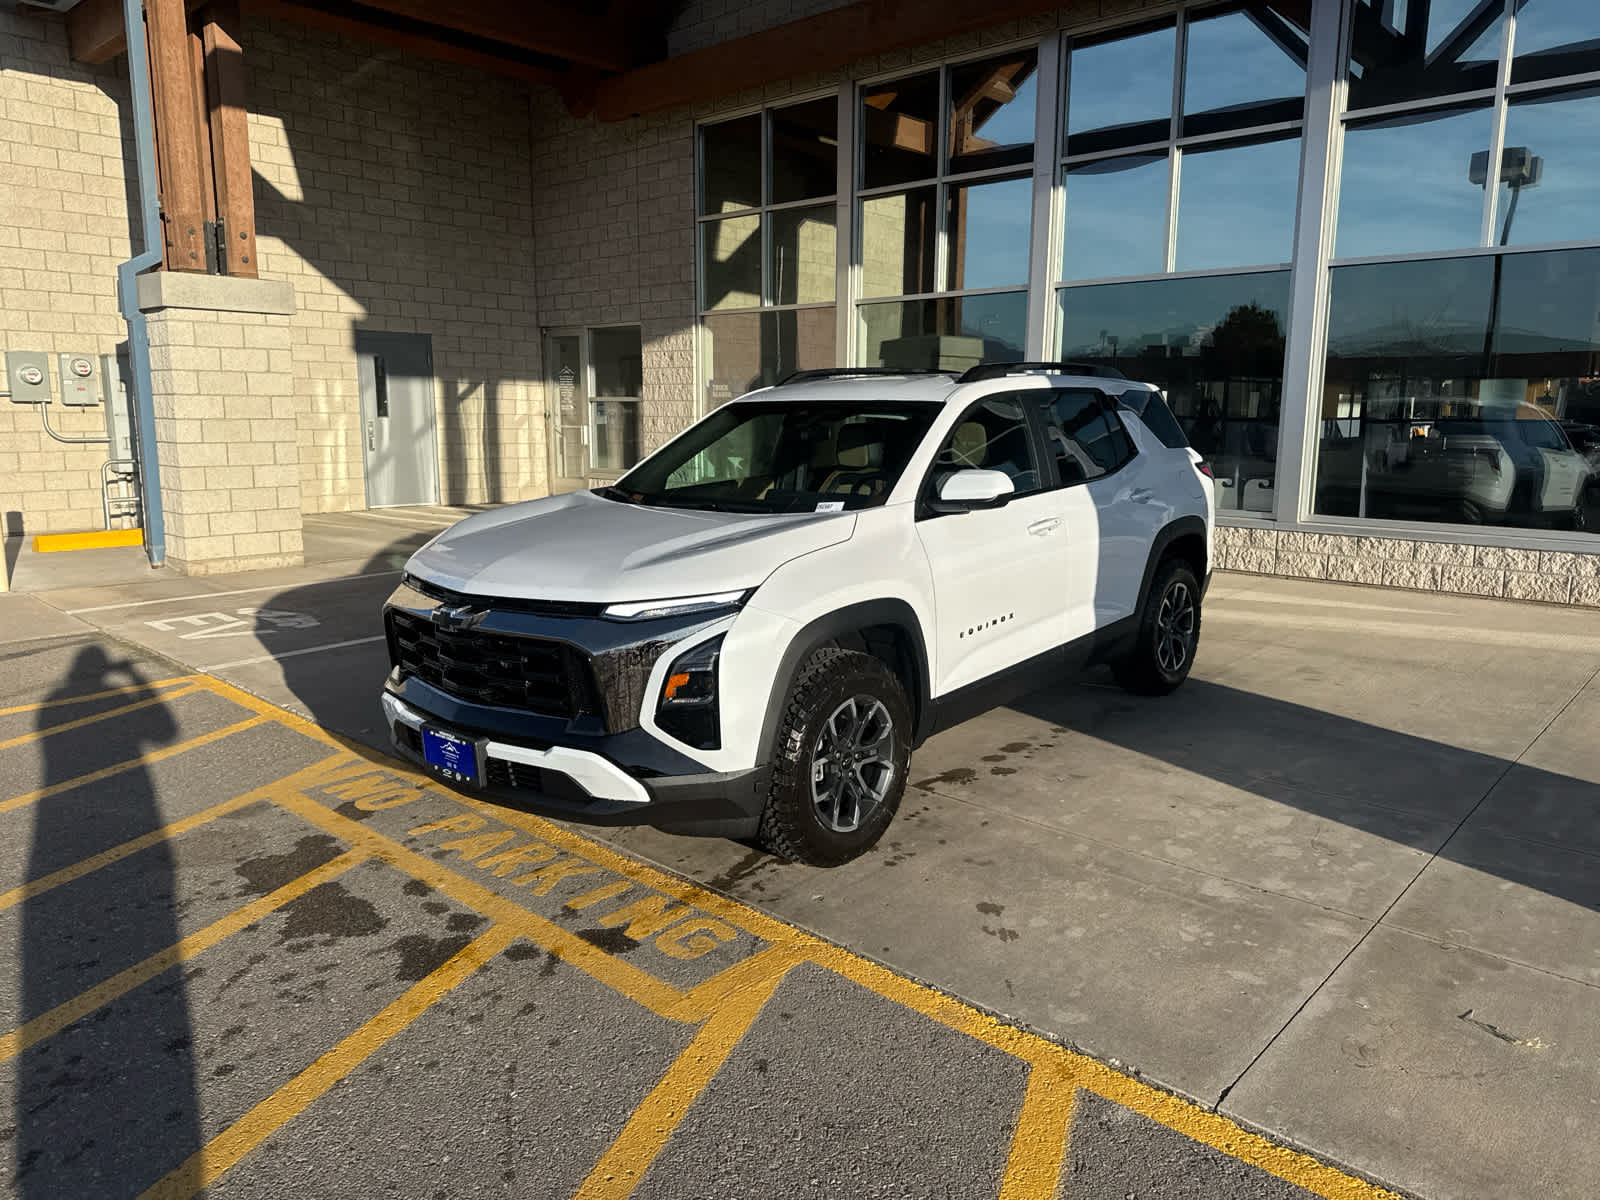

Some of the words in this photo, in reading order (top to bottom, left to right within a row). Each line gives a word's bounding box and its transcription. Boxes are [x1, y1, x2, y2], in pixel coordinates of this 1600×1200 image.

[959, 612, 1014, 639] EQUINOX
[321, 775, 423, 811] NO
[407, 812, 738, 960] PARKING
